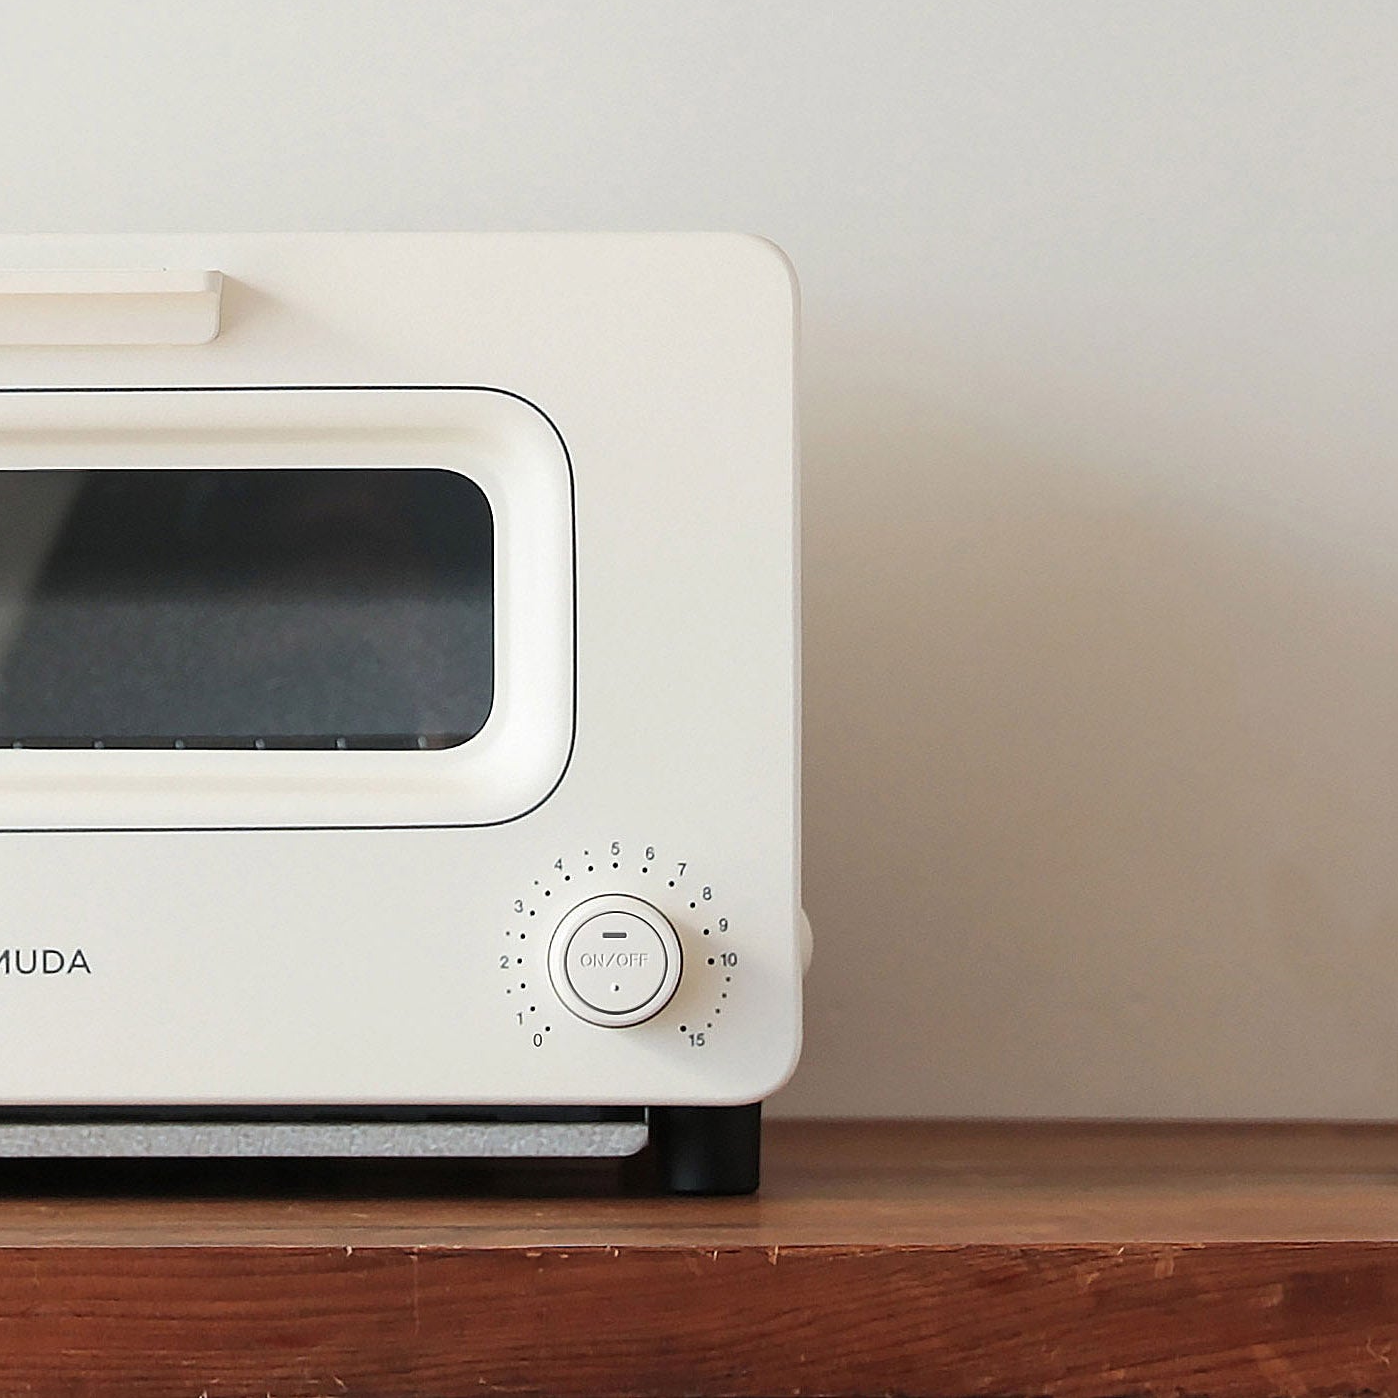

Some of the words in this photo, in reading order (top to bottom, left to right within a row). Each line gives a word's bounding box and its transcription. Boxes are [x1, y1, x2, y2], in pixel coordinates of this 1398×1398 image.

[610, 841, 621, 856] 5
[645, 846, 655, 861] 6
[554, 858, 563, 870] 4
[677, 862, 687, 877] 7
[702, 886, 713, 901] 8
[514, 899, 524, 914] 3
[718, 917, 729, 933] 9
[499, 955, 510, 970] 2
[580, 953, 648, 968] ON/OFF
[720, 952, 738, 967] 10
[516, 1012, 524, 1025] 1
[532, 1033, 543, 1048] 0
[688, 1032, 706, 1047] 15
